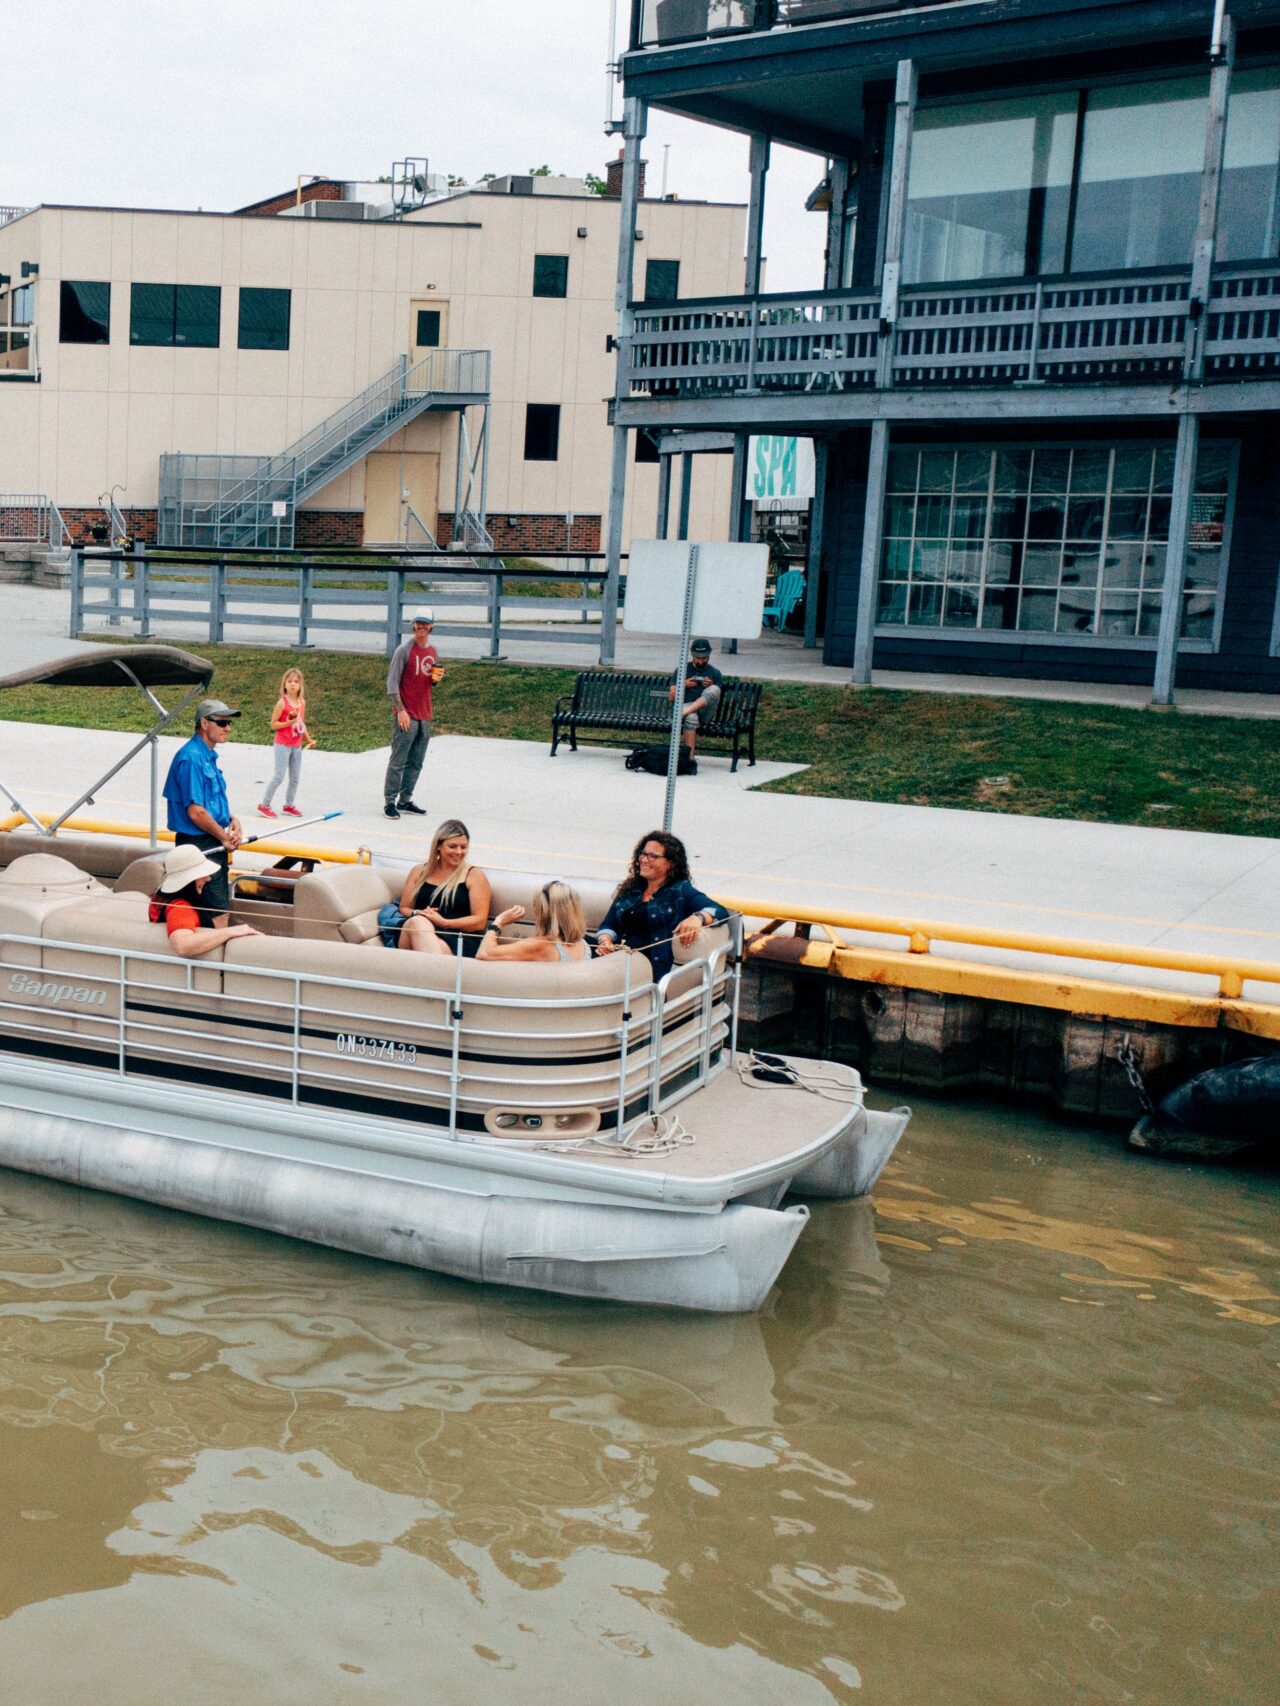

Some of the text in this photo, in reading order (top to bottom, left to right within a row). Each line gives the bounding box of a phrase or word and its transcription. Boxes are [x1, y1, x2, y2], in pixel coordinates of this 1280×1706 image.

[754, 435, 797, 498] SPA
[7, 973, 107, 1005] Sanpan
[336, 1033, 417, 1063] ON337433
